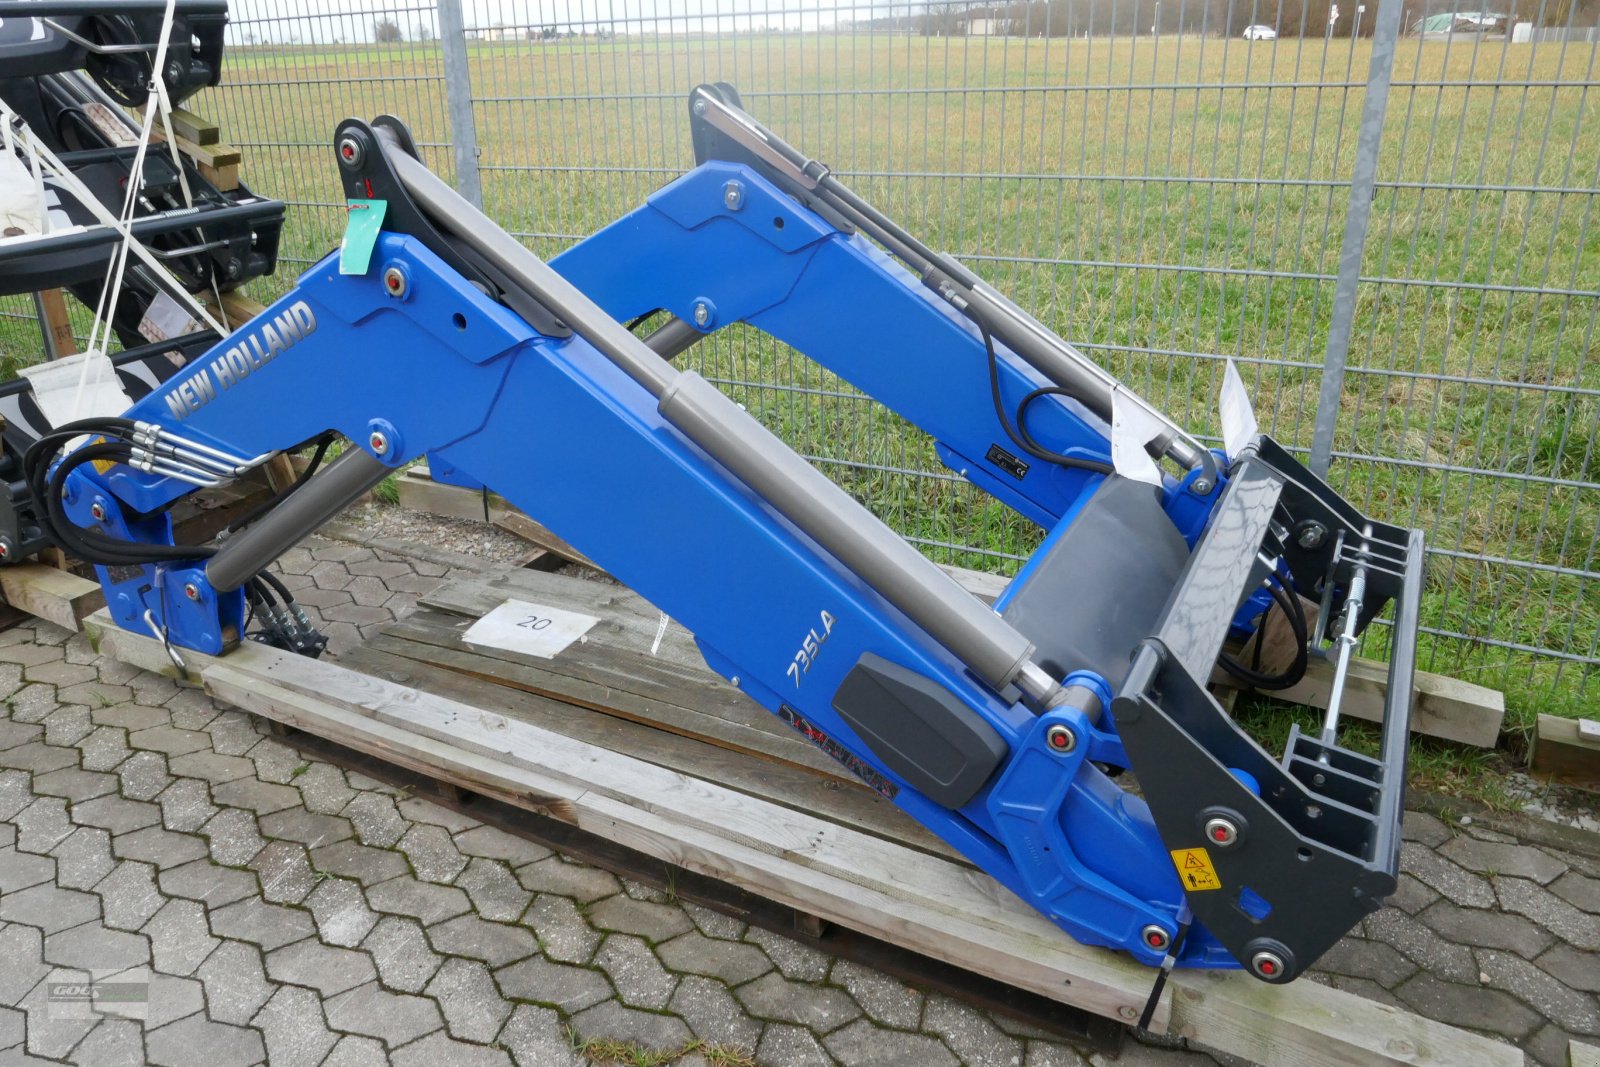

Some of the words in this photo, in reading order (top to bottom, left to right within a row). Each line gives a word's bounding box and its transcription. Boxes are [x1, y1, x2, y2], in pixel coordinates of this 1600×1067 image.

[165, 369, 215, 421] NEW
[210, 301, 317, 391] HOLLAND
[516, 615, 552, 631] 20
[786, 609, 837, 689] 735LA
